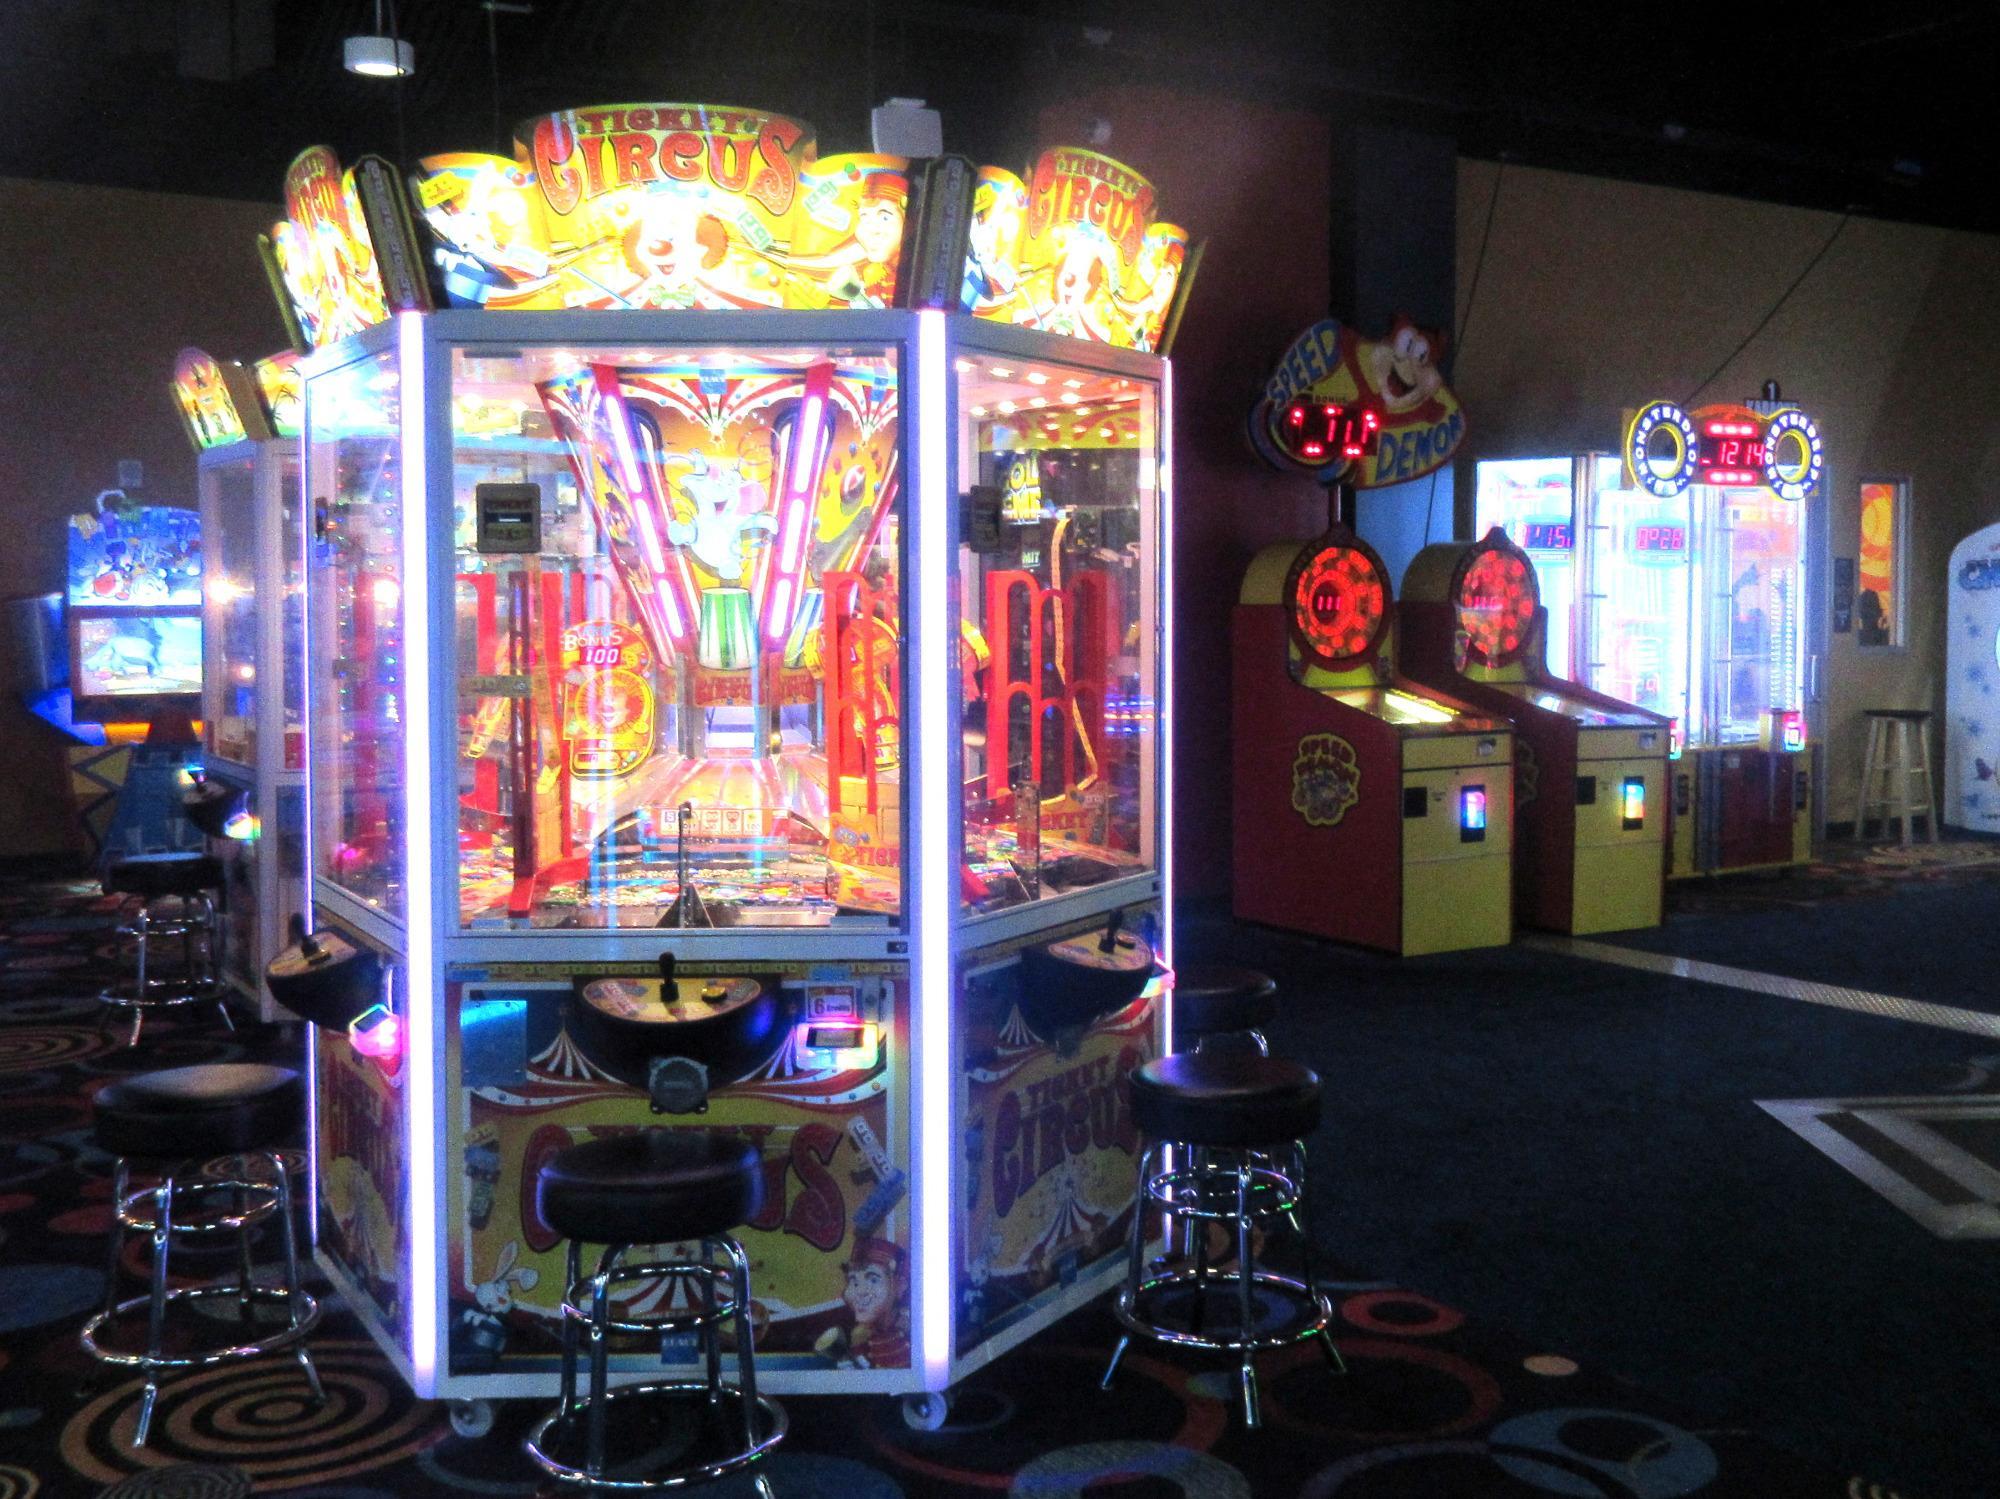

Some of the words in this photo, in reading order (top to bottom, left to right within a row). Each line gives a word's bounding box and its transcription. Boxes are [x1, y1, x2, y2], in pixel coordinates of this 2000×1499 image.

[581, 107, 750, 134] TICKET
[534, 117, 803, 216] CIRCUS
[1029, 149, 1154, 266] CIRCUS
[1267, 319, 1341, 410] SPEED
[1376, 411, 1462, 483] DEMON
[563, 629, 623, 650] BONUS
[586, 648, 619, 663] 100
